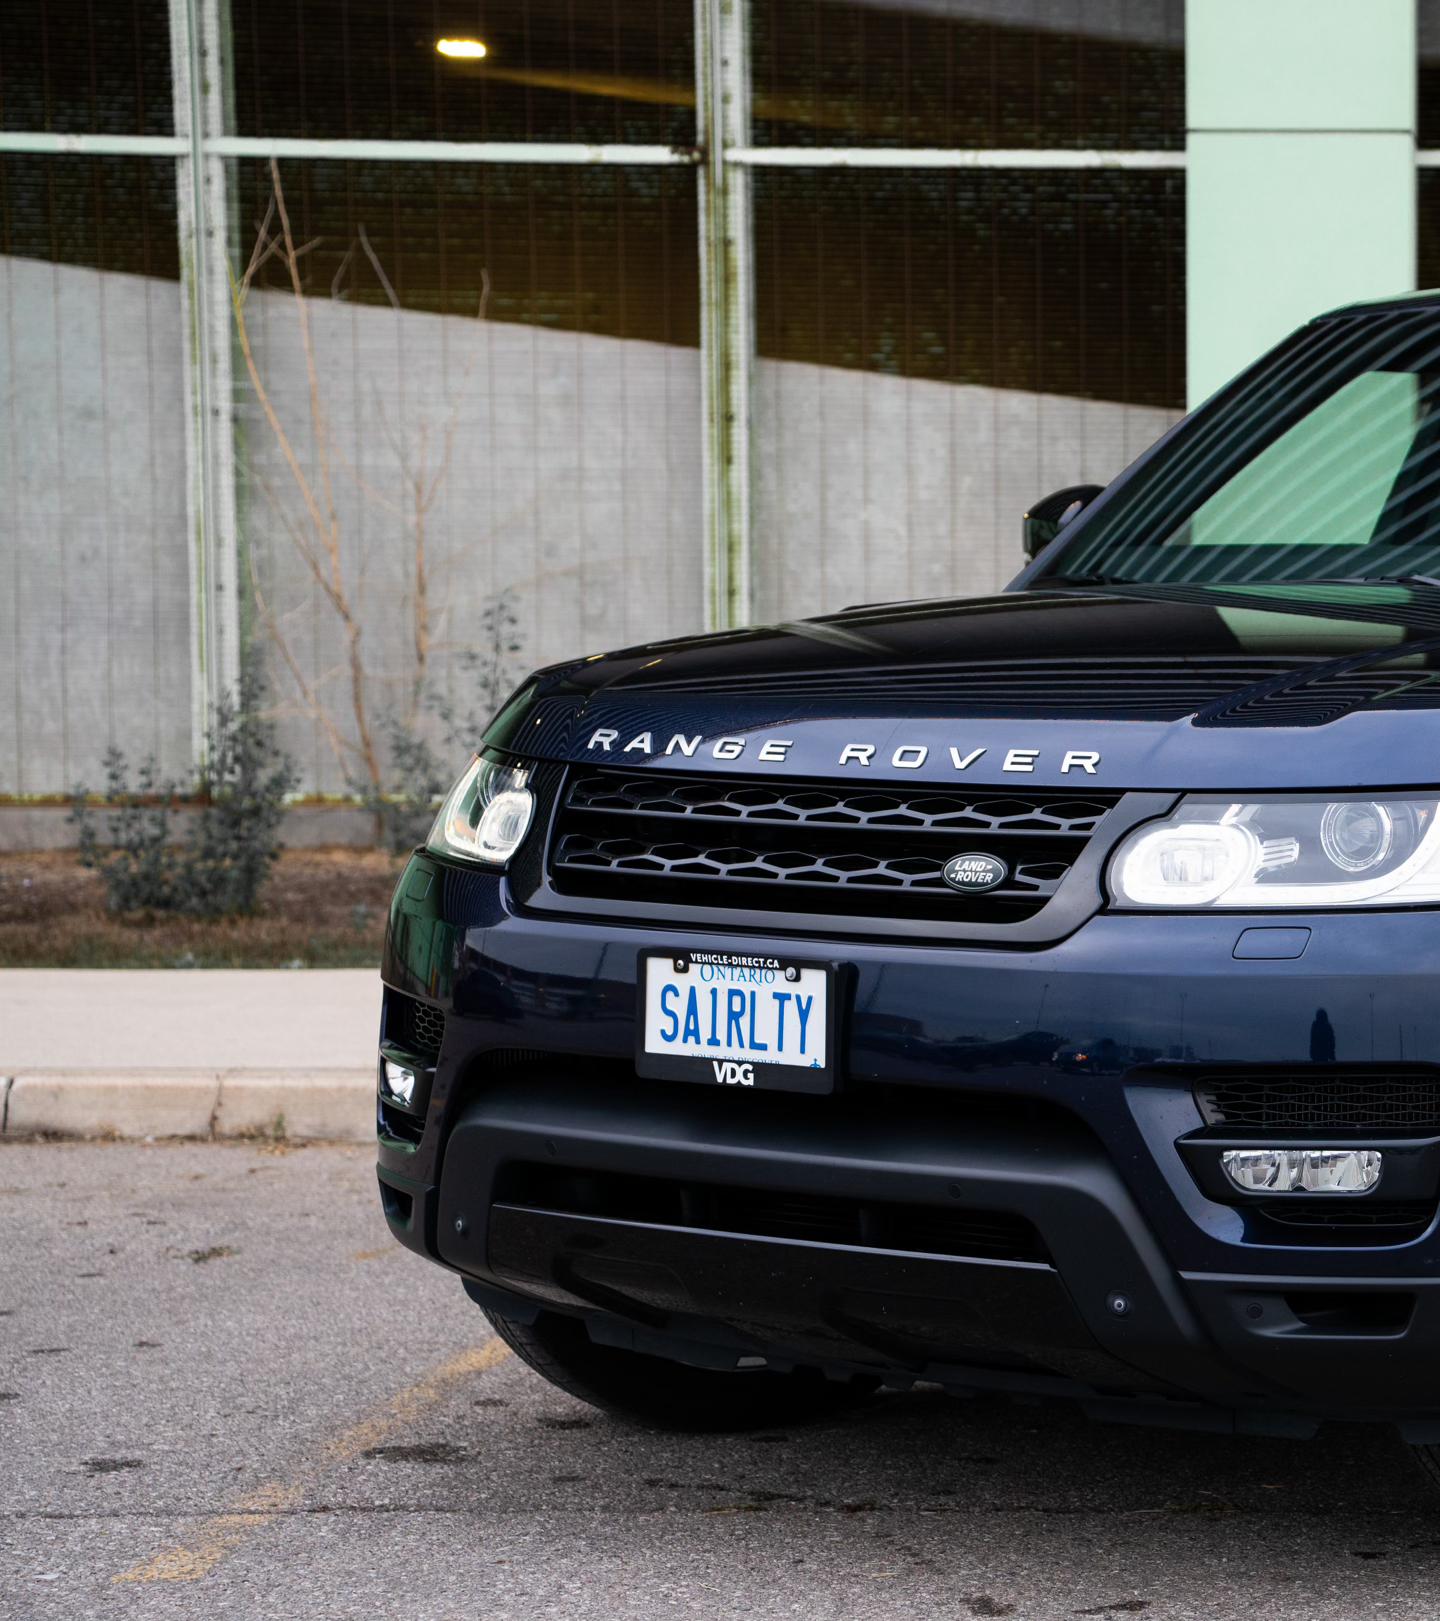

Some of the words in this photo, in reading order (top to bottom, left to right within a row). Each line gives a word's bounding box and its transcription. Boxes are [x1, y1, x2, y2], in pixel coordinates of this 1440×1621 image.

[587, 728, 793, 763] RANGE
[838, 743, 1101, 775] ROVER
[954, 860, 986, 872] LAND
[954, 871, 994, 883] ROVER
[690, 953, 780, 969] VEHICLE-DIRECT.CA
[700, 964, 776, 985] ONTARIO
[660, 983, 814, 1055] SA1RLTY
[712, 1060, 755, 1086] VDG
